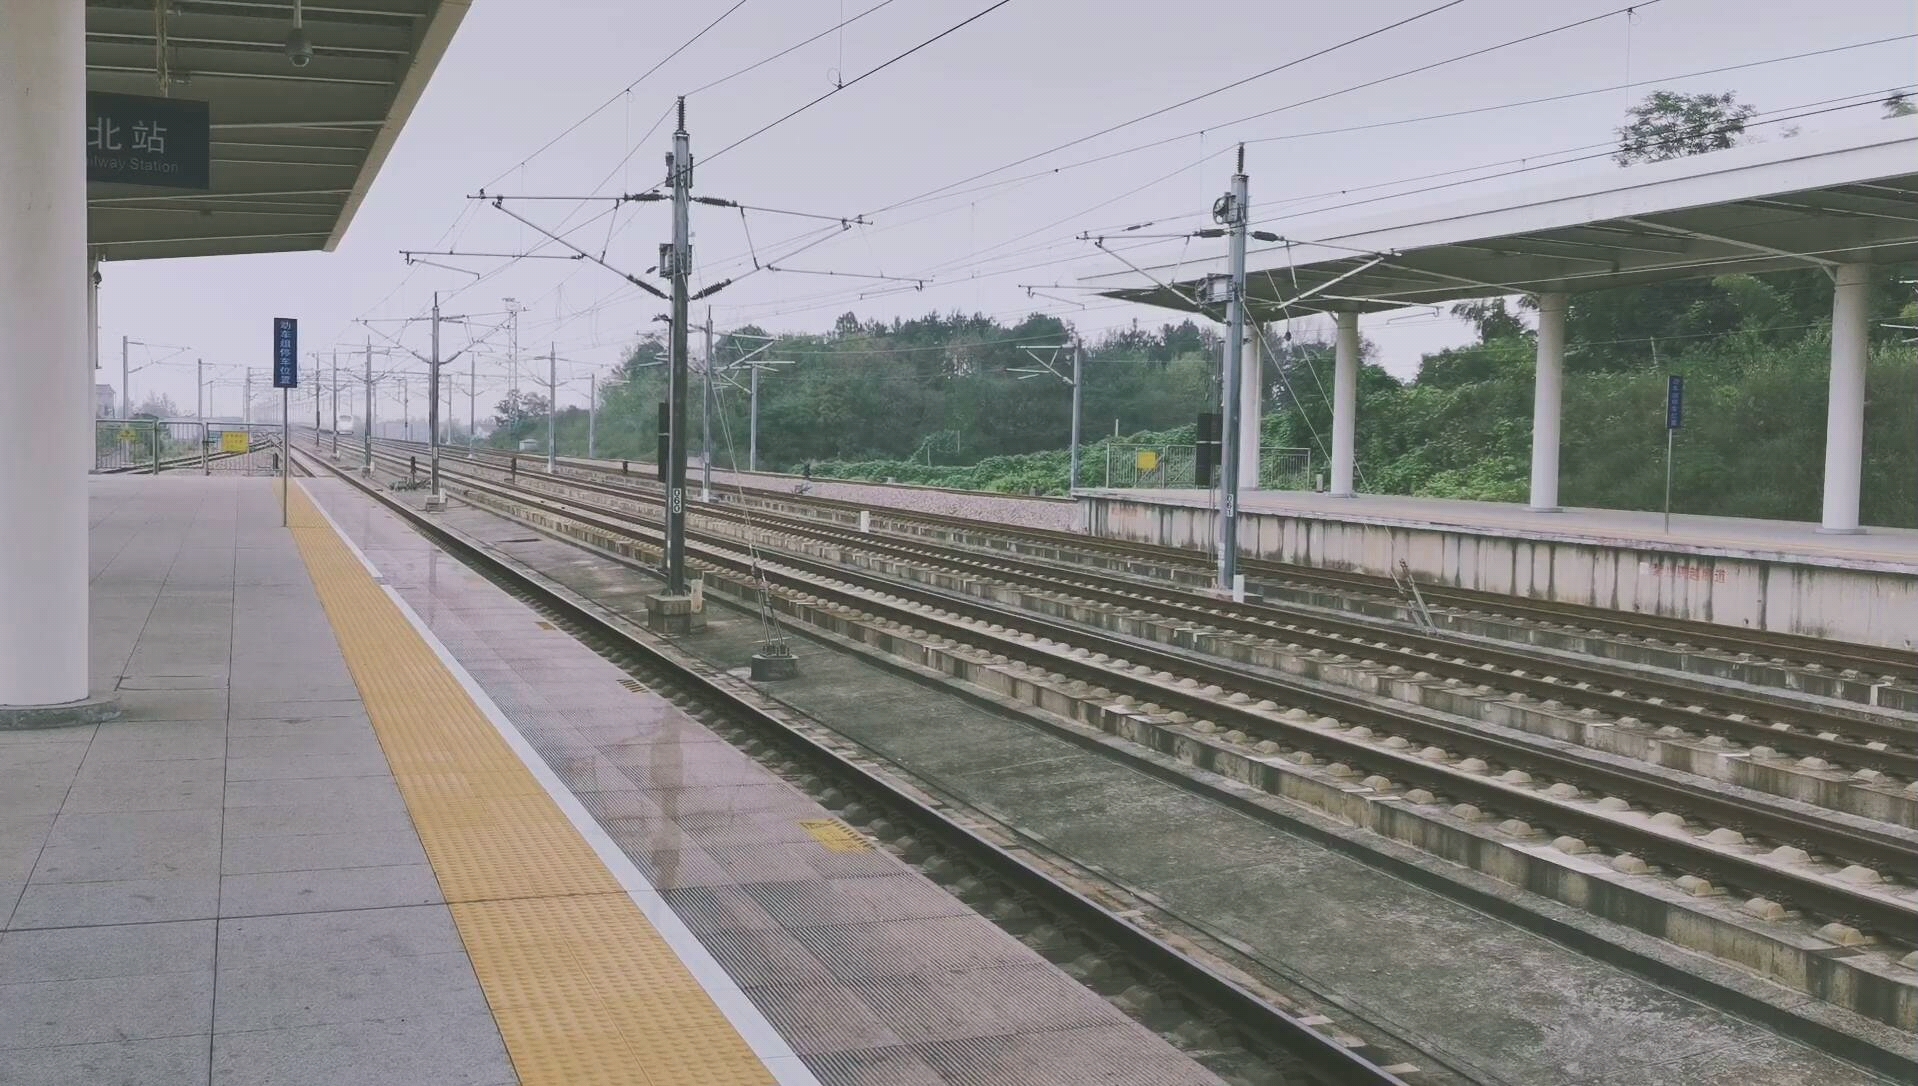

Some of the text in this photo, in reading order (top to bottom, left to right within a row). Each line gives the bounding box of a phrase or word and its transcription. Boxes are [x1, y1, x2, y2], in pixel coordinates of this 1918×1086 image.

[88, 116, 168, 154] 北站
[88, 154, 179, 173] ilway Station
[280, 320, 291, 385] 动车组停车位置
[673, 489, 681, 513] 060
